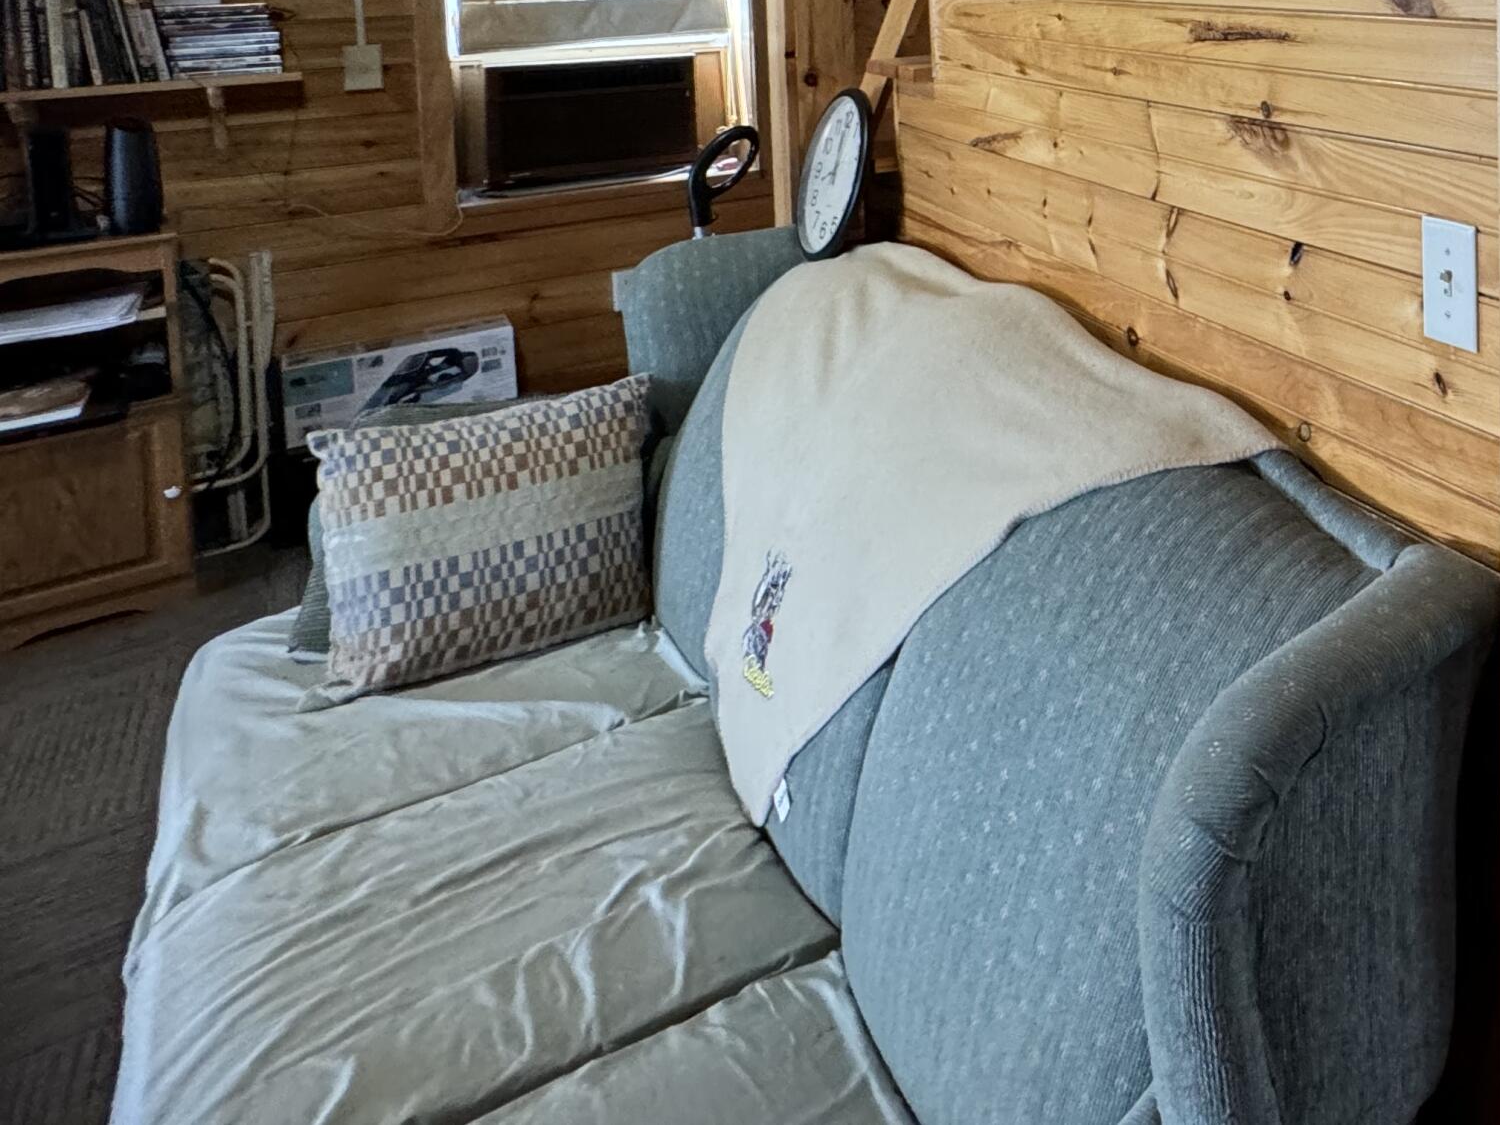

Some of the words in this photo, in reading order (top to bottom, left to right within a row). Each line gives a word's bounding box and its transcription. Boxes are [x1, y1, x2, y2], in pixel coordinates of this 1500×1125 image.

[845, 110, 854, 129] 12
[814, 161, 822, 180] 9
[810, 189, 819, 207] 8
[812, 210, 821, 229] 7
[819, 221, 828, 240] 6
